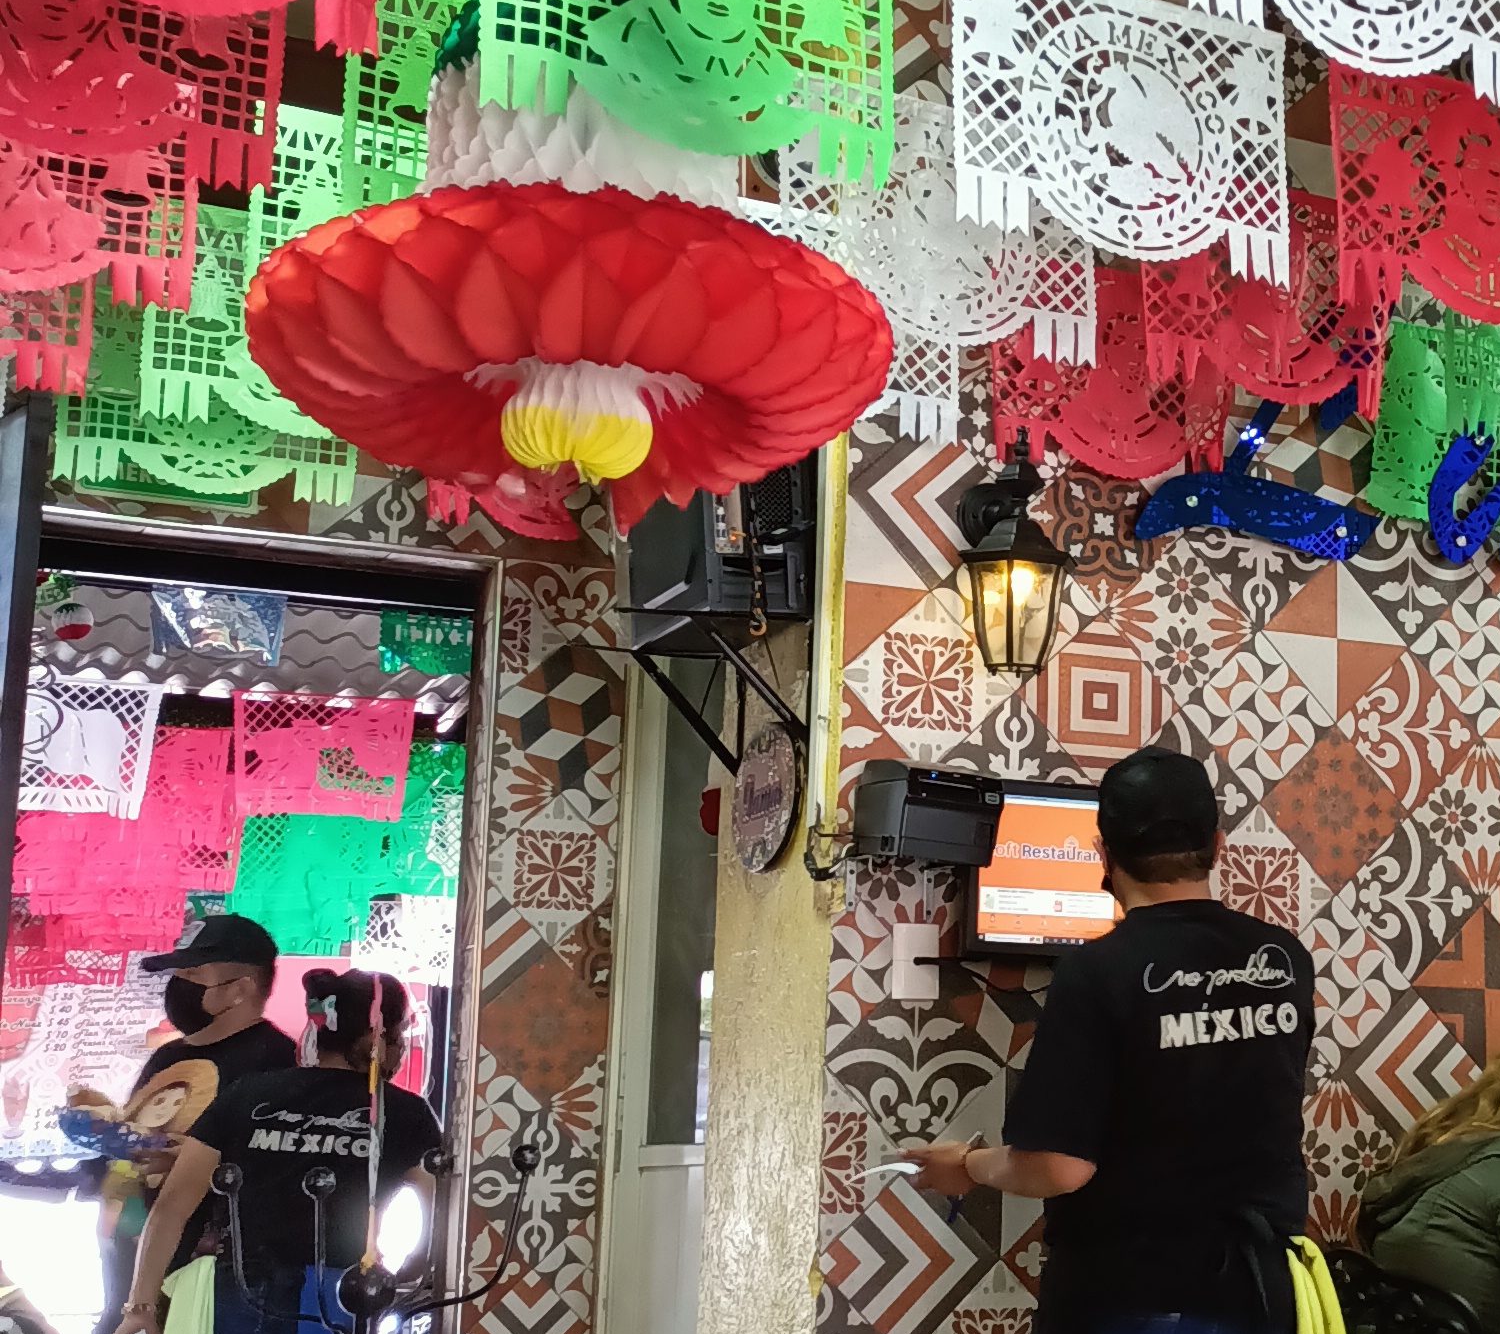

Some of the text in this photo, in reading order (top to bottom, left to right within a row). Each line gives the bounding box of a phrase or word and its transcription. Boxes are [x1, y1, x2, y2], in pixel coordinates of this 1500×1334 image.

[1029, 20, 1225, 135] VIVA MEXICO
[994, 841, 1103, 863] oft Restauran
